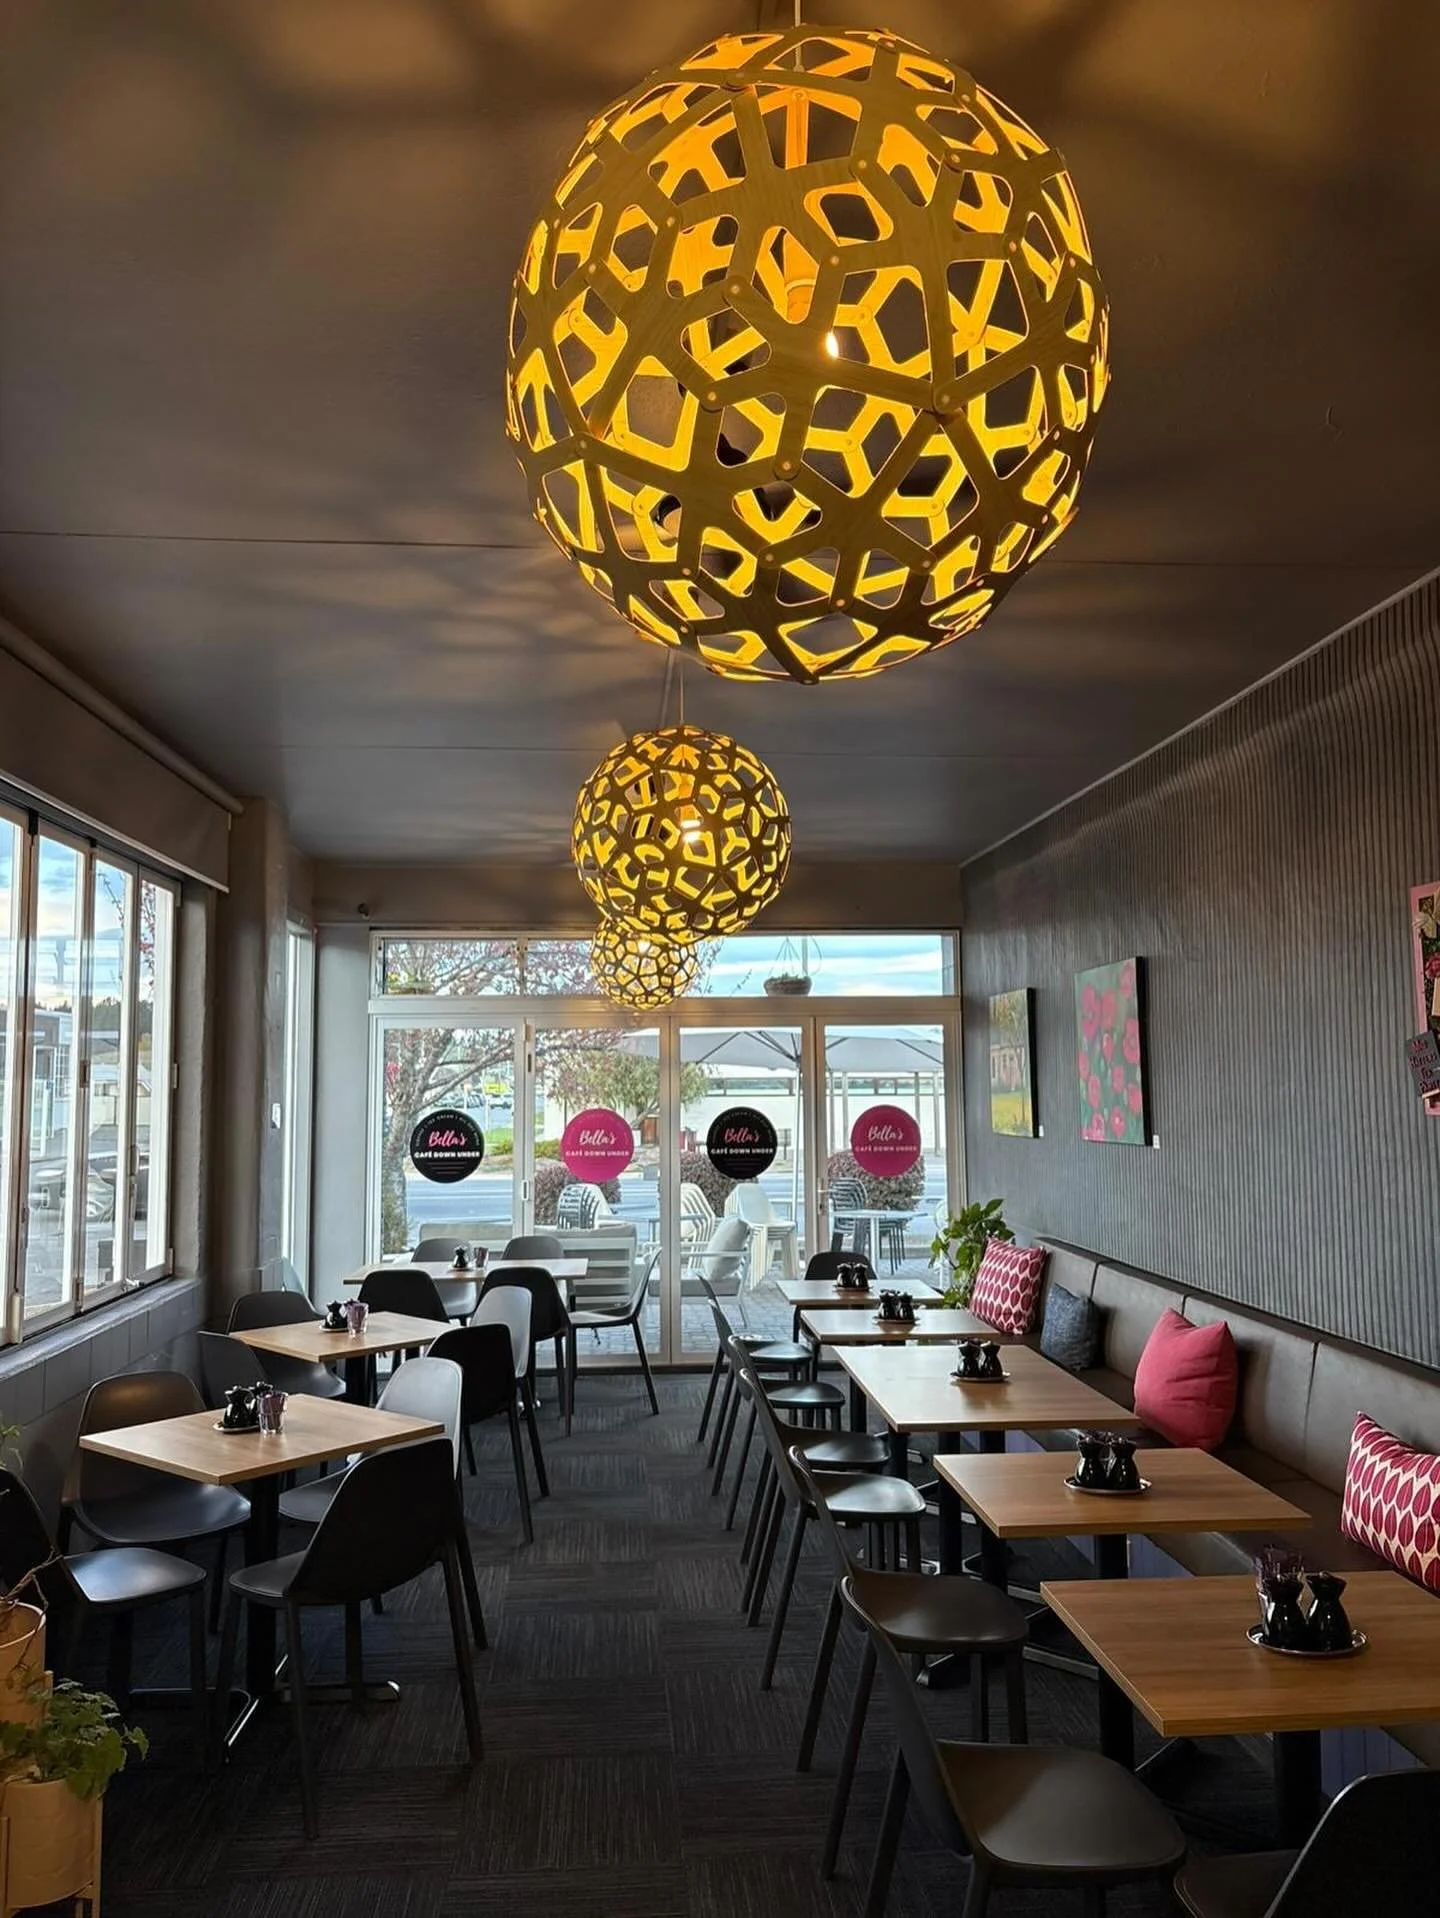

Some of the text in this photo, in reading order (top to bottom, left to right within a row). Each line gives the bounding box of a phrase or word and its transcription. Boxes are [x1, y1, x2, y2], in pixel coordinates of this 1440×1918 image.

[428, 1129, 467, 1148] Bella's
[579, 1128, 616, 1146] Bella's
[724, 1126, 760, 1144] Bella's
[868, 1124, 904, 1142] Bella's
[414, 1151, 433, 1159] CAFÉ
